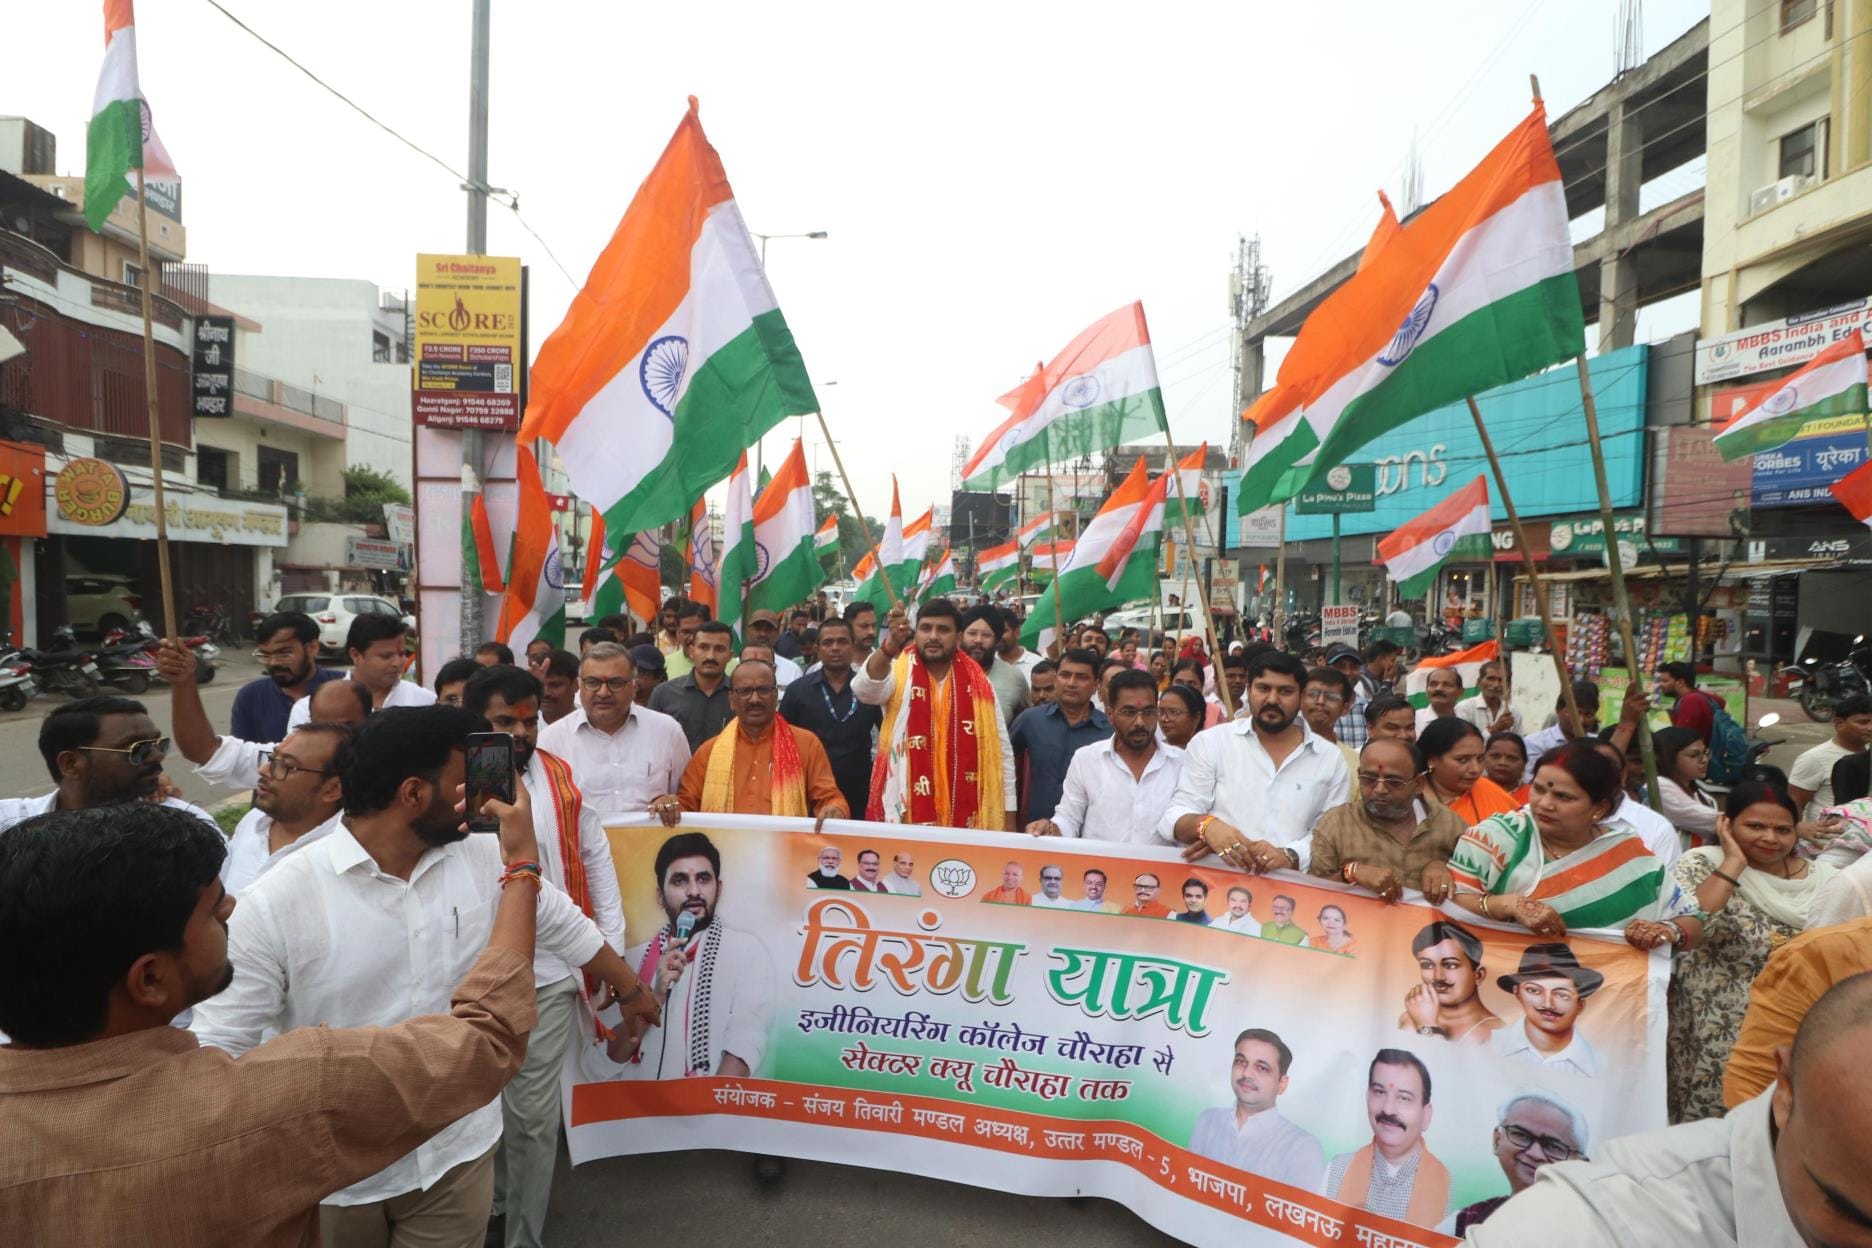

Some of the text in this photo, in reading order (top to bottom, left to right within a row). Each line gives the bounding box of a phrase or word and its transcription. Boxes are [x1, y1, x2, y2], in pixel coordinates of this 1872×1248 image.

[419, 310, 507, 332] SCORE
[1736, 329, 1781, 351] MBBS
[1785, 320, 1825, 340] India
[1829, 310, 1860, 328] and
[205, 343, 220, 366] जी
[1758, 333, 1827, 360] Aarambh
[1816, 446, 1861, 471] यूरेका
[57, 461, 121, 522] WAT A BURGER
[1303, 494, 1315, 504] La
[1788, 488, 1811, 500] ANS
[1324, 606, 1357, 618] MBBS
[913, 775, 931, 796] श्री
[796, 897, 1228, 1033] तिरंगा यात्रा
[798, 1005, 1175, 1075] इजीनियरिंग कॉलेज चौराहा से
[841, 1042, 1132, 1102] सेक्टर क्यू चौराहा तक
[712, 1084, 777, 1109] संयोजक
[803, 1093, 845, 1117] संजय
[853, 1098, 903, 1123] तिवारी
[912, 1108, 965, 1133] मण्डल
[974, 1118, 1036, 1150] अध्यक्ष,
[1044, 1128, 1085, 1151] उत्तर
[1093, 1133, 1143, 1161] मण्डल
[1160, 1156, 1176, 1184] 5,
[1188, 1166, 1253, 1213] भाजपा,
[1263, 1193, 1345, 1241] लखनऊ
